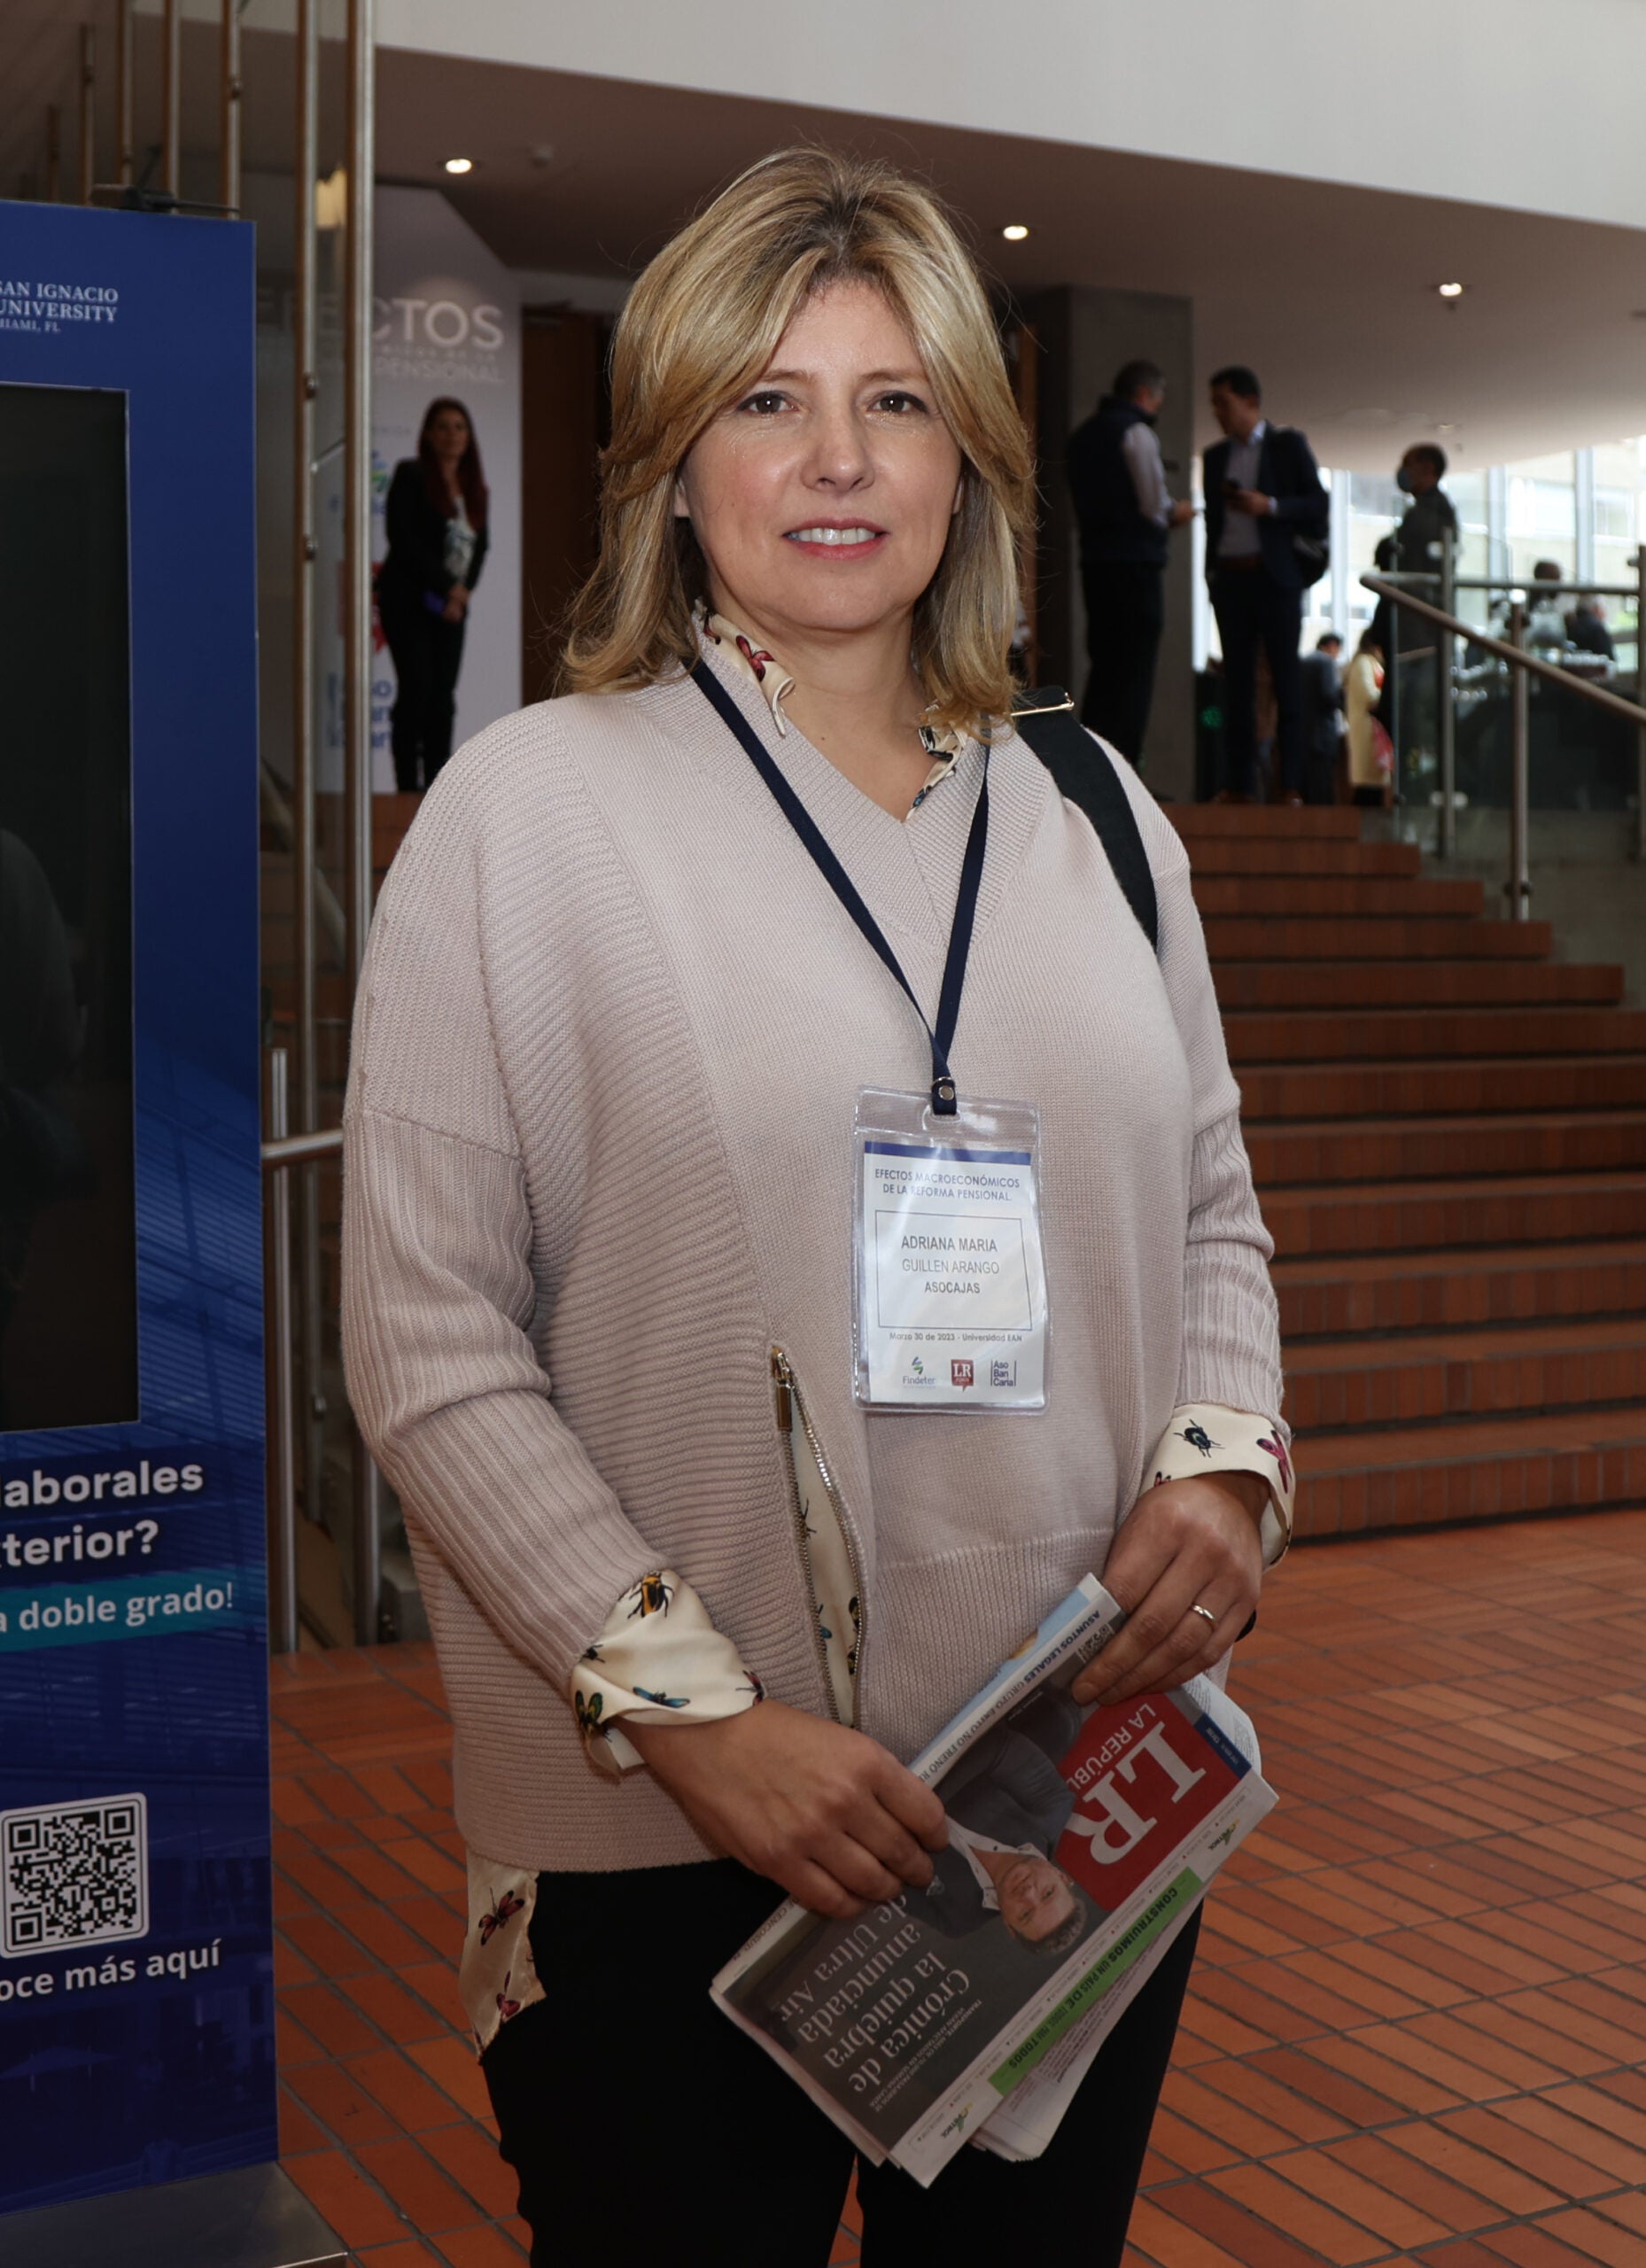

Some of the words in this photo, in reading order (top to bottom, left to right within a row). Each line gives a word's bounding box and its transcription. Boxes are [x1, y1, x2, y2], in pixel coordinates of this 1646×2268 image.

[36, 283, 119, 303] IGNACIO
[44, 321, 61, 333] FL
[875, 1169, 912, 1181] EFECTOS
[915, 1173, 1021, 1188] MACROECONÓMICOS
[883, 1184, 894, 1193] DE
[897, 1184, 907, 1194] LA
[911, 1185, 955, 1198] REFORMA
[958, 1189, 1013, 1201] PENSIONAL
[901, 1235, 956, 1251] ADRIANA
[959, 1238, 998, 1253] MARIA
[902, 1258, 949, 1273] GUILLEN
[951, 1261, 999, 1275] ARANGO
[924, 1281, 981, 1294] ASOCAJAS
[889, 1332, 912, 1341] Marzo
[914, 1332, 924, 1341] 30
[926, 1332, 936, 1341] de
[962, 1333, 1005, 1342] Universidad
[953, 1363, 972, 1378] LR
[994, 1360, 1009, 1369] Aso
[994, 1369, 1009, 1378] Ban
[903, 1376, 936, 1385] Findeter
[4, 1460, 204, 1507] aborales
[0, 1519, 159, 1566] terior?
[19, 1596, 117, 1630] doble
[125, 1582, 233, 1627] grado!
[1060, 1610, 1099, 1650] ASUNTOS
[1022, 1646, 1061, 1683] LEGALES
[993, 1679, 1025, 1710] GRUPO
[1126, 1702, 1156, 1727] LA
[954, 1730, 972, 1748] NO
[1065, 1720, 1207, 1864] LR
[872, 1895, 906, 1923] de
[1106, 1886, 1178, 1962] CONSTRUIMOS
[65, 1955, 136, 1991] más
[146, 1938, 221, 1980] aquí
[812, 1922, 879, 1981] Ultra
[912, 1950, 946, 1978] la
[1096, 1959, 1111, 1975] UN
[796, 1922, 920, 2043] anunciada
[1078, 1971, 1100, 1994] PAÍS
[777, 1979, 814, 2022] Air
[1064, 1989, 1083, 2009] DE
[821, 1978, 916, 2068] quiebra
[878, 1968, 972, 2060] Crónica
[1007, 2037, 1039, 2069] TODOS
[847, 2058, 881, 2092] de
